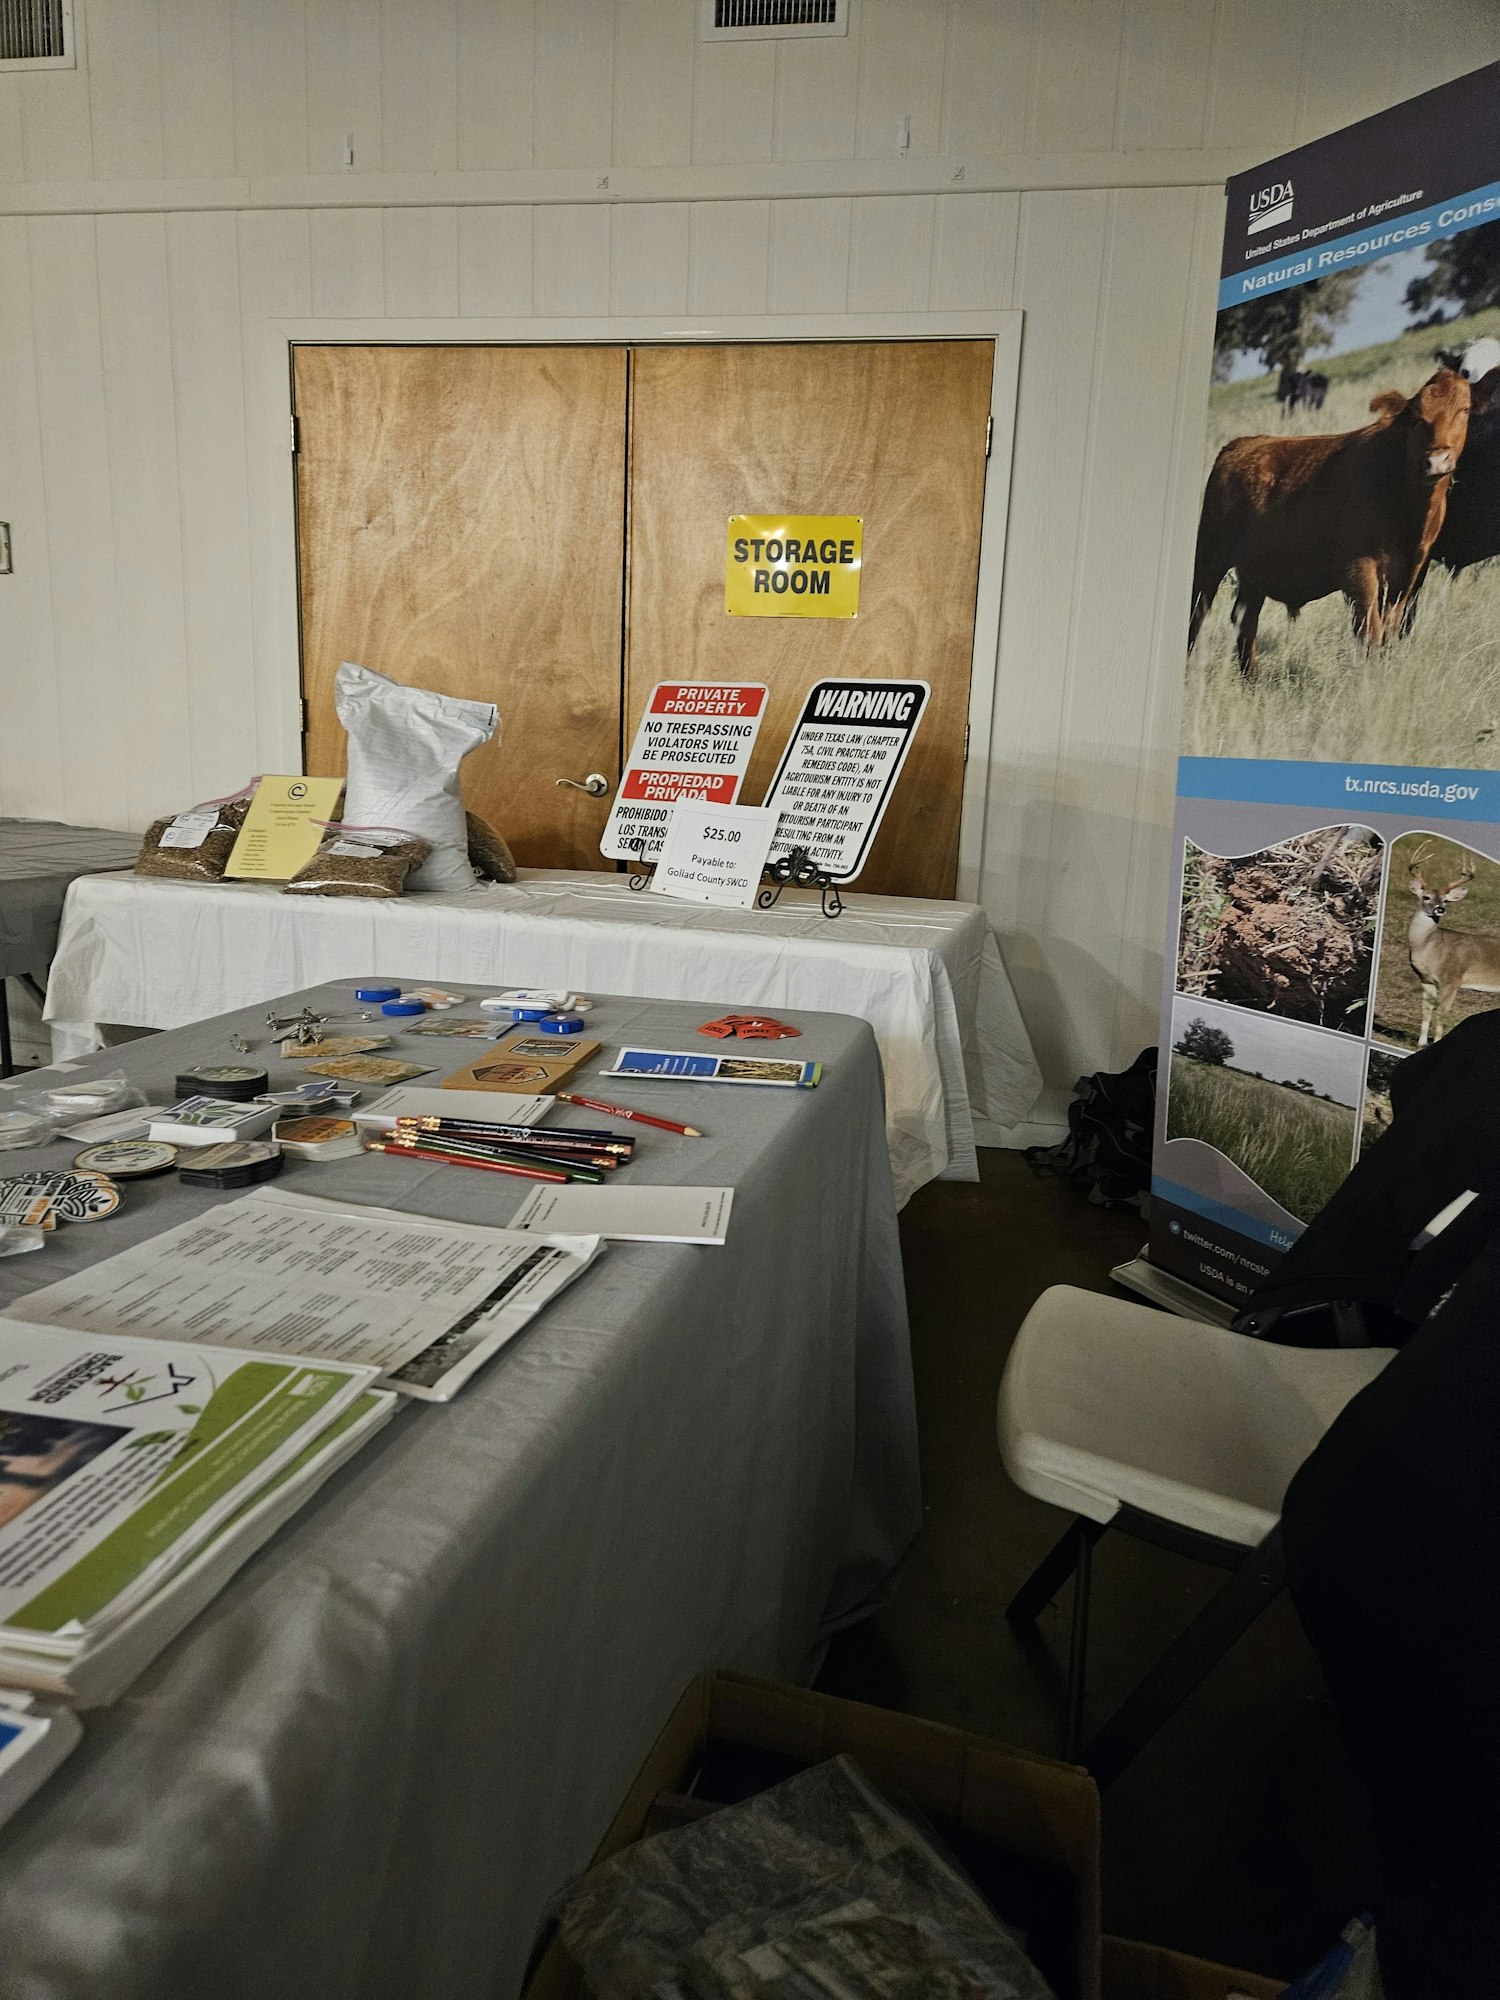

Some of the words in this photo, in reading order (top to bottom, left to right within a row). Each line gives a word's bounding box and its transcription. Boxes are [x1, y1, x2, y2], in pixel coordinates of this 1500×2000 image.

[1250, 179, 1295, 212] USDA
[1245, 240, 1272, 260] United
[1273, 233, 1300, 252] States
[1302, 213, 1356, 240] Department
[1356, 207, 1368, 220] of
[1367, 189, 1424, 217] Agriculture
[1242, 259, 1312, 293] Natural
[1318, 219, 1431, 268] Resources
[734, 538, 855, 564] STORAGE
[754, 570, 831, 594] ROOM
[676, 688, 741, 701] PRIVATE
[664, 701, 747, 714] PROPERTY
[813, 689, 916, 722] WARNING
[644, 721, 663, 733] NO
[666, 722, 753, 737] TRESPASSING
[648, 737, 709, 750] VIOLATORS
[712, 739, 740, 752] WILL
[800, 731, 823, 742] UNDER
[824, 732, 848, 743] TEXAS
[845, 734, 864, 744] LAW
[863, 735, 900, 747] (CHAPTER
[642, 750, 659, 761] BE
[660, 750, 736, 765] PROSECUTED
[800, 745, 815, 756] 75A,
[816, 746, 834, 757] CIVIL
[835, 748, 870, 760] PRACTICE
[871, 750, 888, 760] AND
[801, 759, 837, 771] REMEDIES
[837, 761, 861, 774] CODE),
[862, 764, 875, 774] AN
[638, 772, 724, 789] PROPIEDAD
[784, 772, 832, 785] AGRITOURISM
[832, 775, 858, 786] ENTITY
[857, 777, 866, 787] IS
[865, 779, 883, 790] NOT
[644, 786, 708, 801] PRIVADA
[782, 785, 806, 797] LIABLE
[806, 787, 821, 798] FOR
[821, 789, 837, 800] ANY
[836, 790, 863, 802] INJURY
[862, 793, 873, 804] TO
[1345, 776, 1480, 803] tx.nrcs.usda.gov
[616, 806, 668, 822] PROHIBIDO
[792, 801, 803, 811] OR
[804, 803, 827, 814] DEATH
[827, 805, 838, 815] OF
[837, 806, 850, 816] AN
[618, 823, 636, 836] LOS
[637, 825, 669, 838] TRANS
[778, 813, 816, 827] RITOURISM
[816, 817, 864, 833] PARTICIPANT
[702, 826, 742, 843] $25.00
[774, 827, 812, 841] RESULTING
[812, 831, 834, 844] FROM
[834, 835, 846, 845] AN
[691, 854, 725, 869] Payable
[725, 859, 737, 869] to:
[810, 846, 844, 861] ACTIVITY.
[667, 867, 695, 880] Goliad
[696, 872, 725, 888] County
[725, 877, 748, 889] SWCD
[1200, 1261, 1225, 1282] USDA
[1225, 1274, 1235, 1288] is
[1235, 1282, 1248, 1294] an
[44, 1352, 124, 1405] BACKYARD
